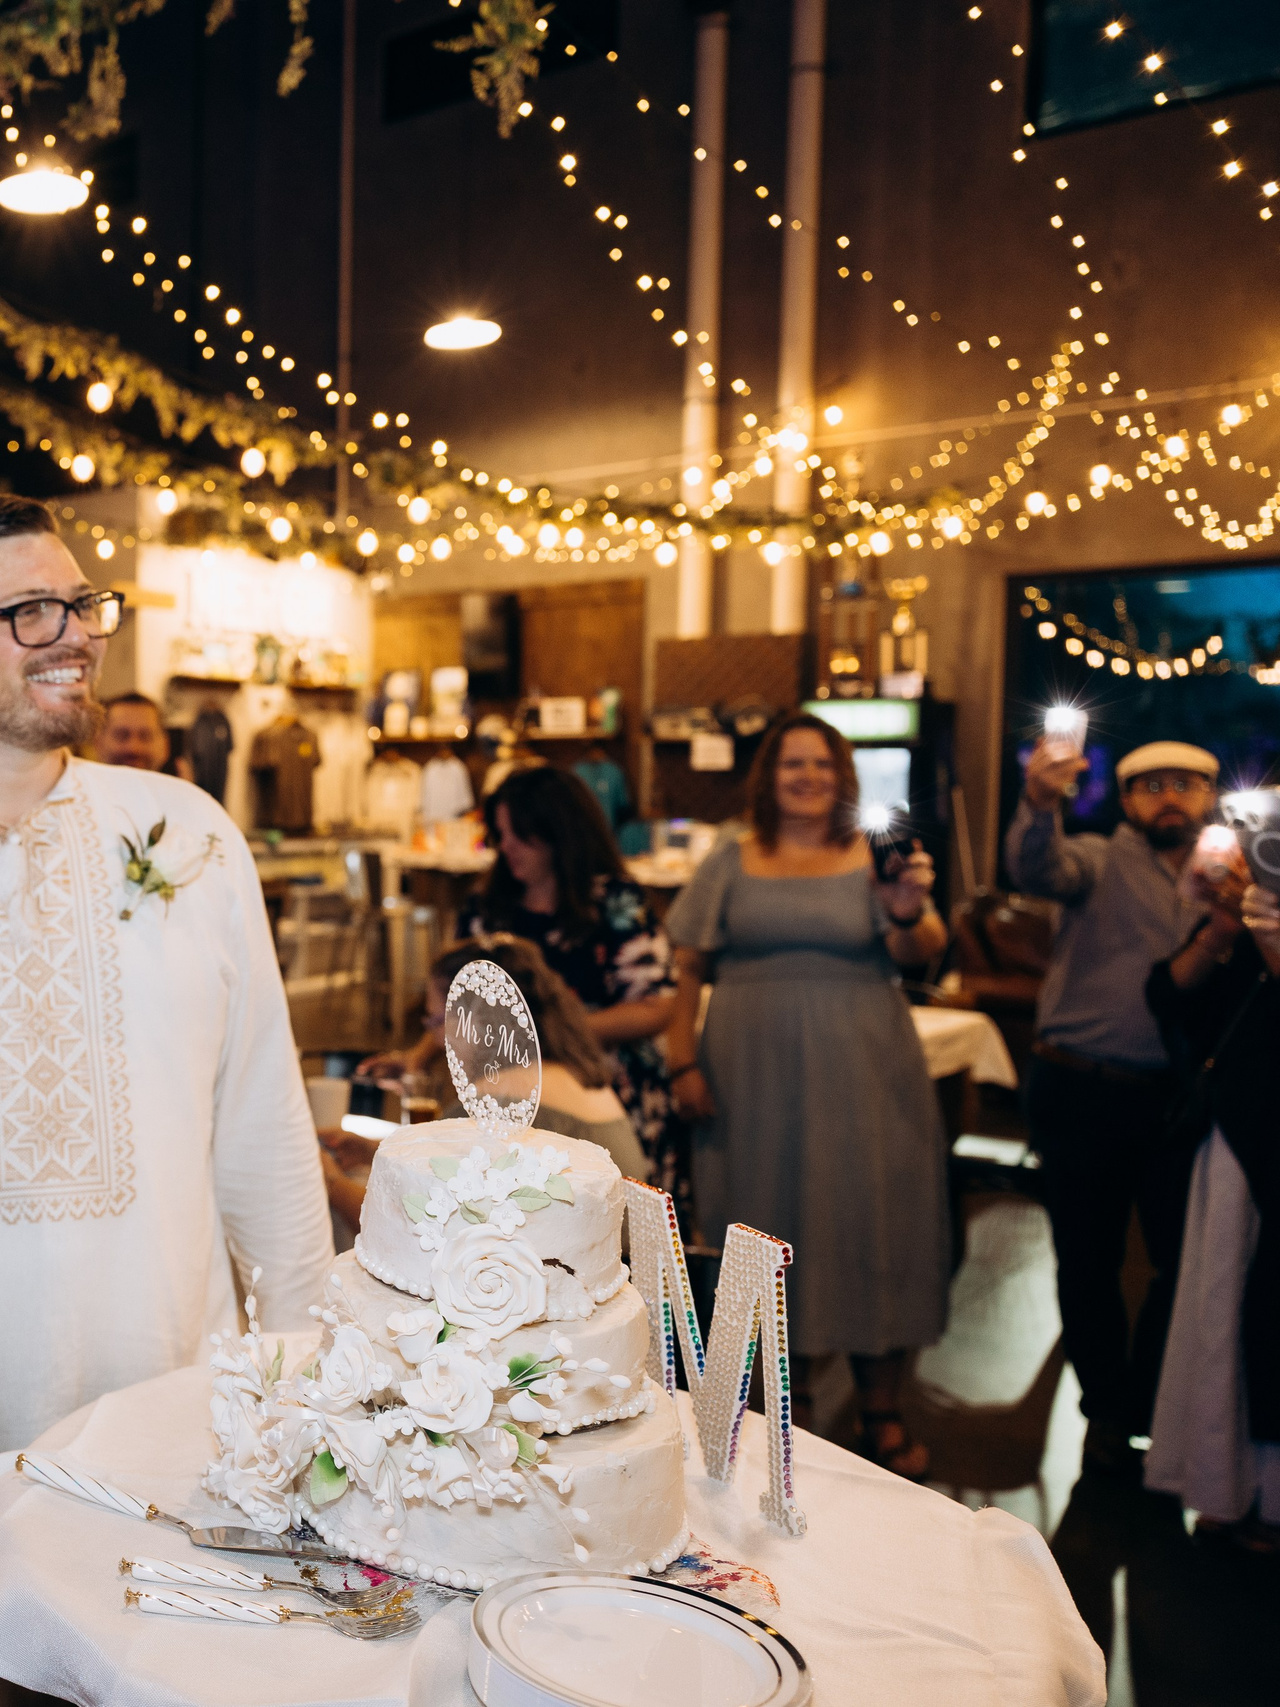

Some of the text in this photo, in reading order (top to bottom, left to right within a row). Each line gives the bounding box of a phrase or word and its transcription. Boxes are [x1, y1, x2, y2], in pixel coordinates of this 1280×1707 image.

[455, 1005, 531, 1069] Mr & Mrs
[621, 1175, 808, 1538] M
